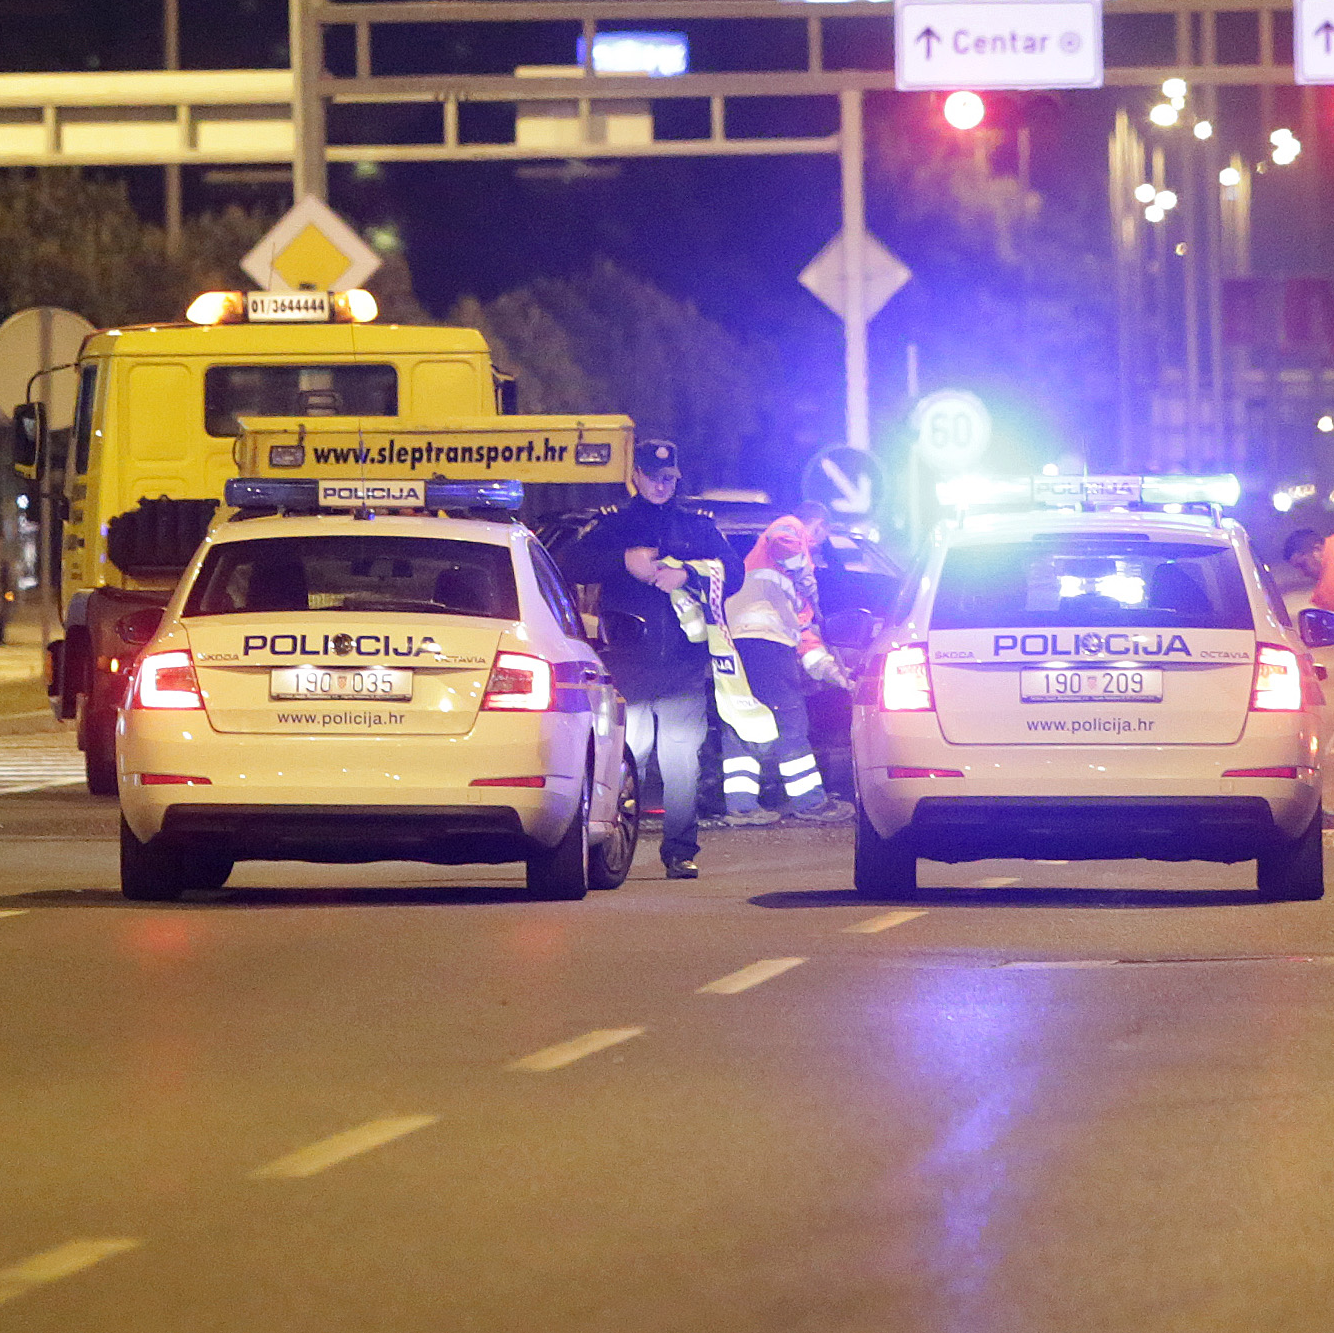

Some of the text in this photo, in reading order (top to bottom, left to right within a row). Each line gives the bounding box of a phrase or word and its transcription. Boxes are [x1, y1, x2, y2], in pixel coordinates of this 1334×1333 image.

[953, 28, 1049, 54] Centar
[251, 298, 324, 314] 01/3644444
[930, 412, 971, 447] 60
[314, 438, 568, 470] www.sleptransport.hr
[323, 487, 421, 500] POLICIJA
[243, 634, 443, 657] POLICIJA
[994, 633, 1192, 656] POLICIJA
[294, 672, 393, 693] 190 035
[1044, 672, 1144, 694] 190 209
[277, 711, 405, 727] www.policija.hr
[1026, 717, 1155, 732] www.policija.hr
